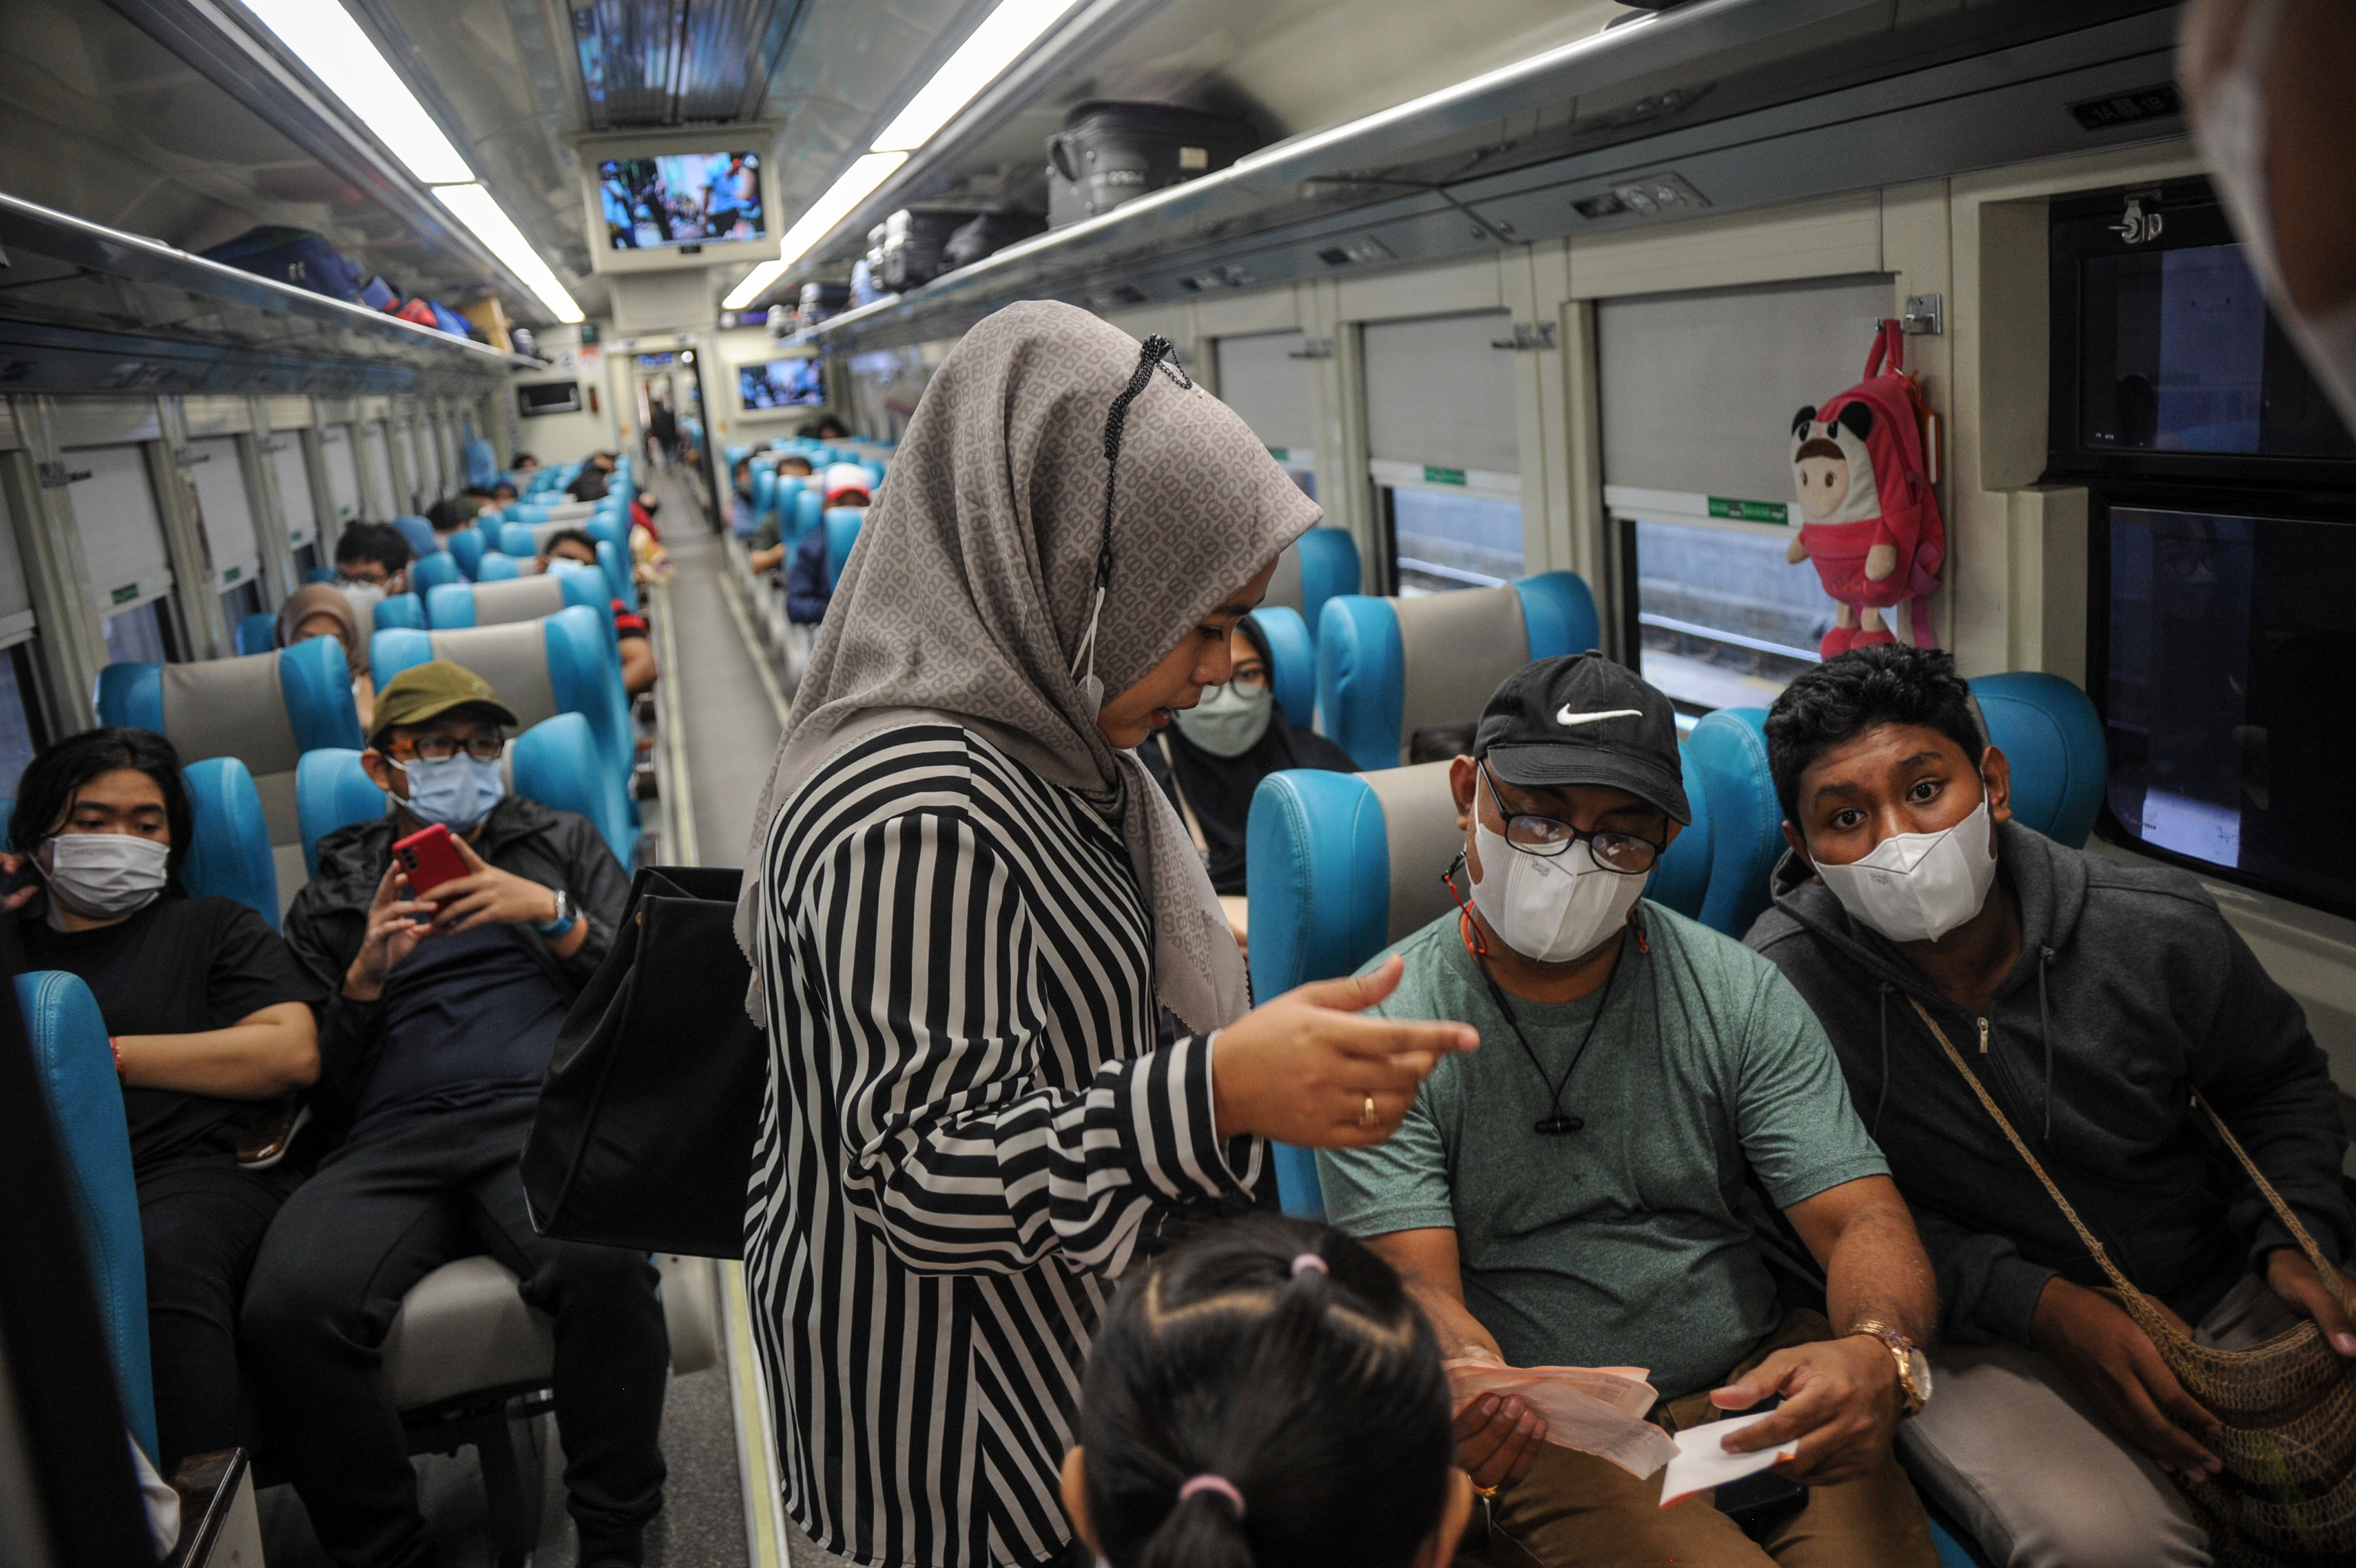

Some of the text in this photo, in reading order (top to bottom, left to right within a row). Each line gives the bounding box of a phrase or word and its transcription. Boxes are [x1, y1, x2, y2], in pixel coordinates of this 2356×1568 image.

[2092, 96, 2166, 120] 1A 1B
[1532, 860, 1550, 876] Sensi
